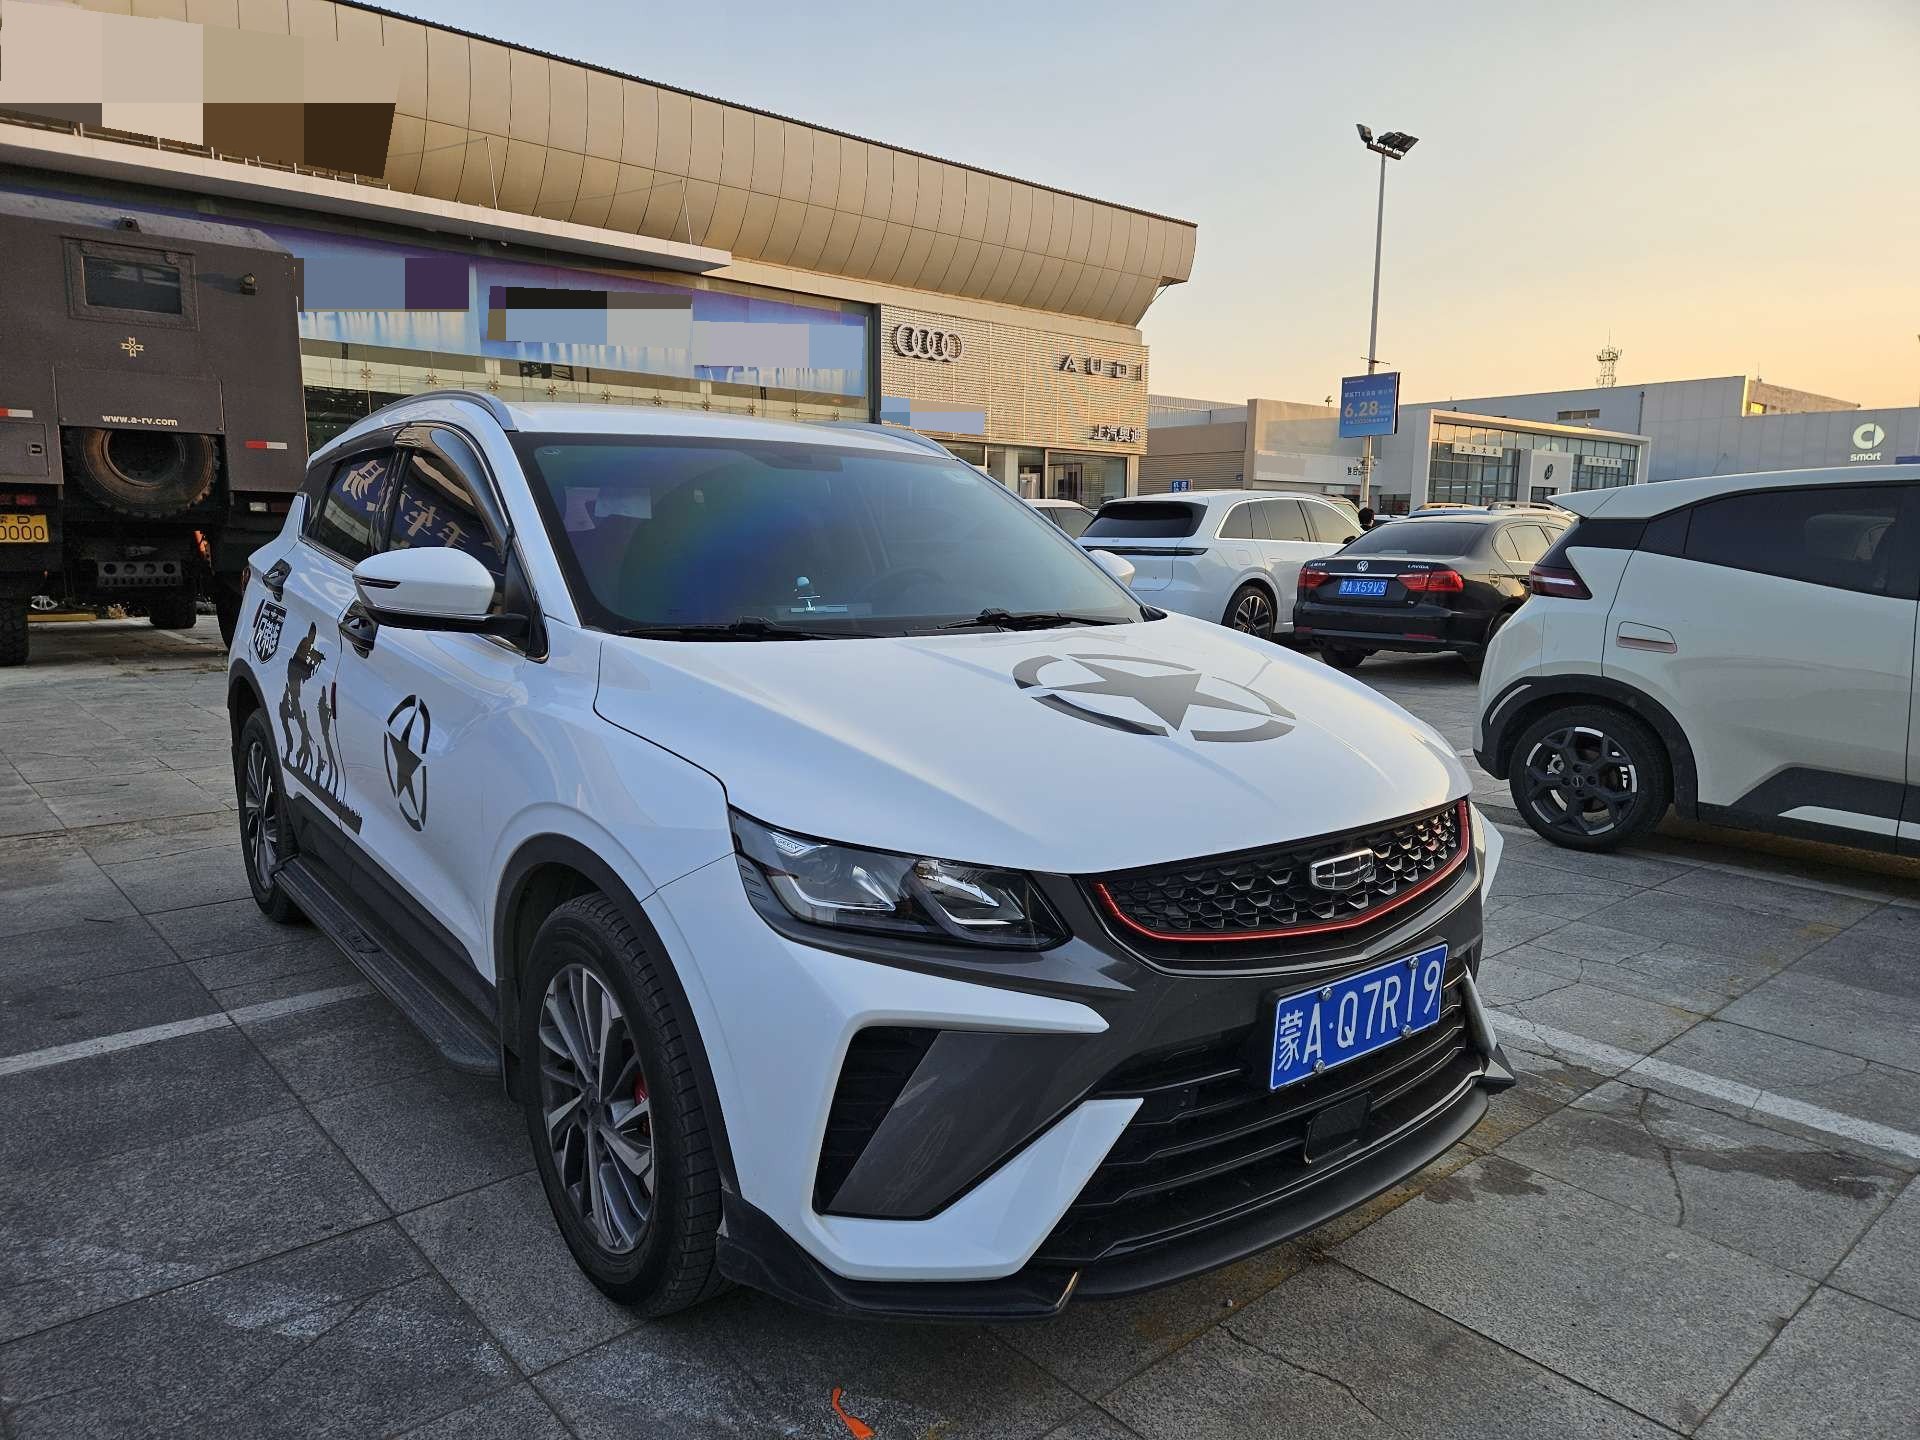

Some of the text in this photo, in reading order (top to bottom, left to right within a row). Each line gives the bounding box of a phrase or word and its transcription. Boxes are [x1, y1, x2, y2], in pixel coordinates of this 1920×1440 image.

[1060, 353, 1144, 381] AUDI
[1344, 400, 1379, 418] 6.28
[1093, 423, 1142, 443] 上汽奥迪
[1849, 452, 1882, 462] smart
[1277, 960, 1441, 1071] 蒙A·Q7R19
